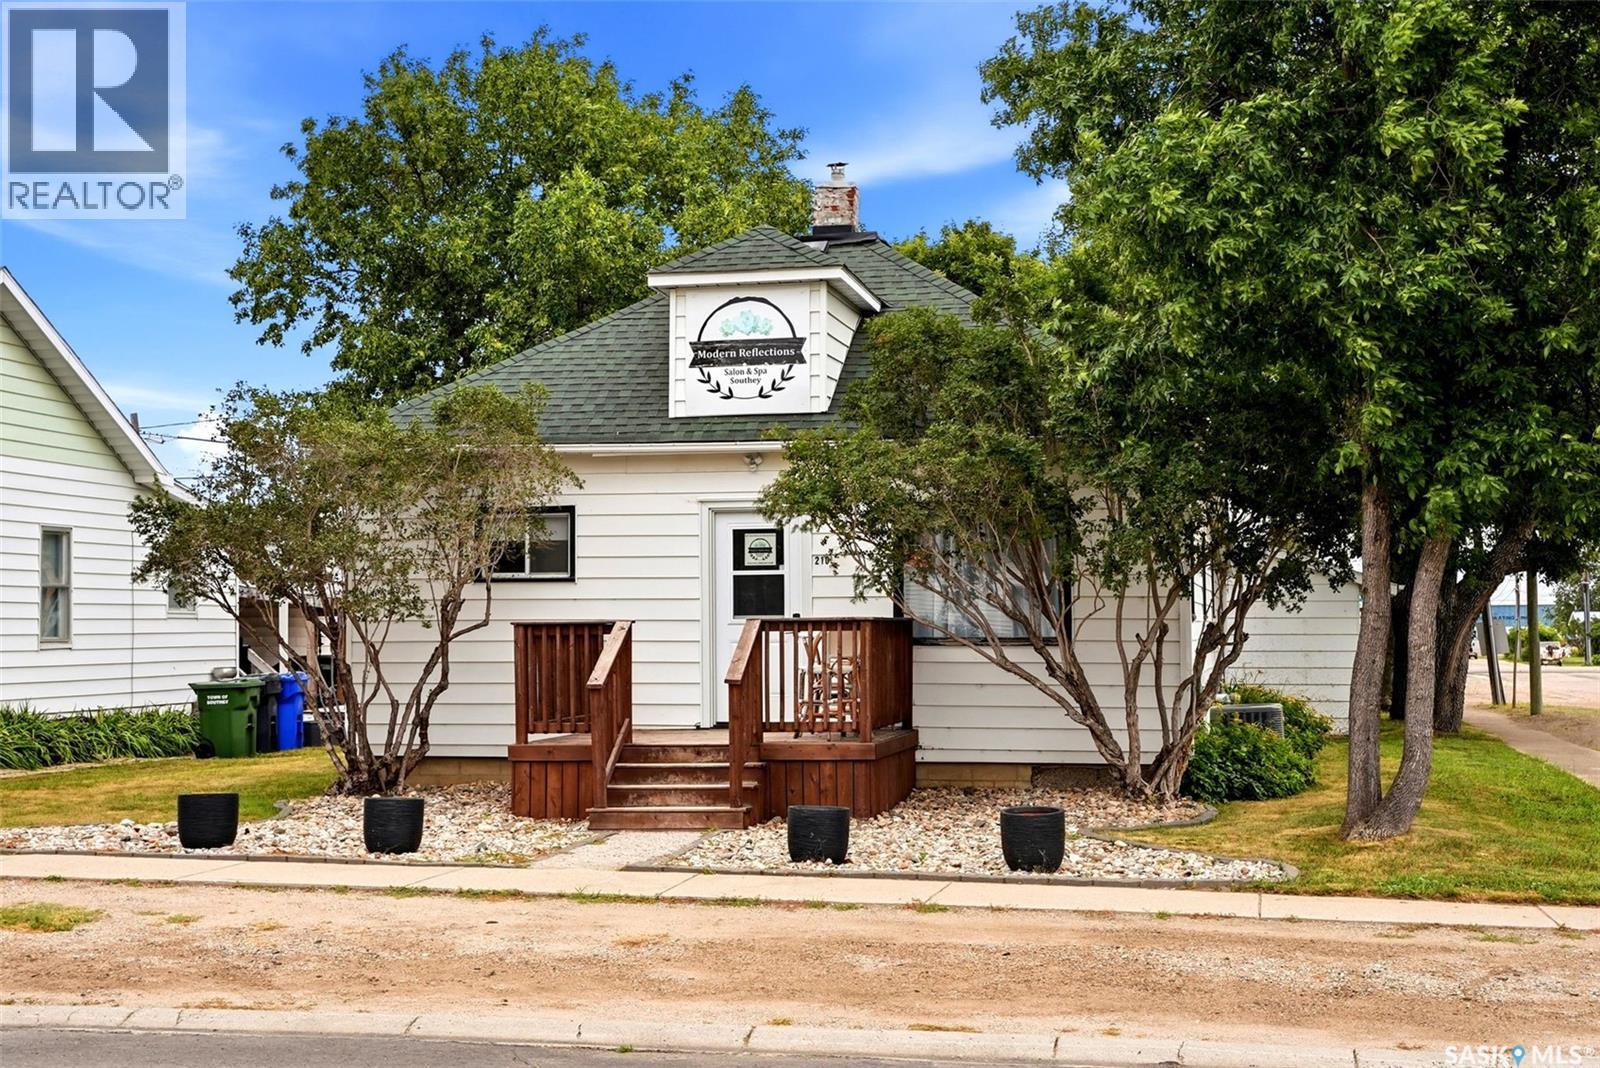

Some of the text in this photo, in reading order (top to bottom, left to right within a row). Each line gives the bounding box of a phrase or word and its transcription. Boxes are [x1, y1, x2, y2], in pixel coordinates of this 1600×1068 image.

[697, 347, 796, 359] Modern Reflections
[724, 367, 768, 377] Salon & Spa
[730, 376, 762, 385] Southey
